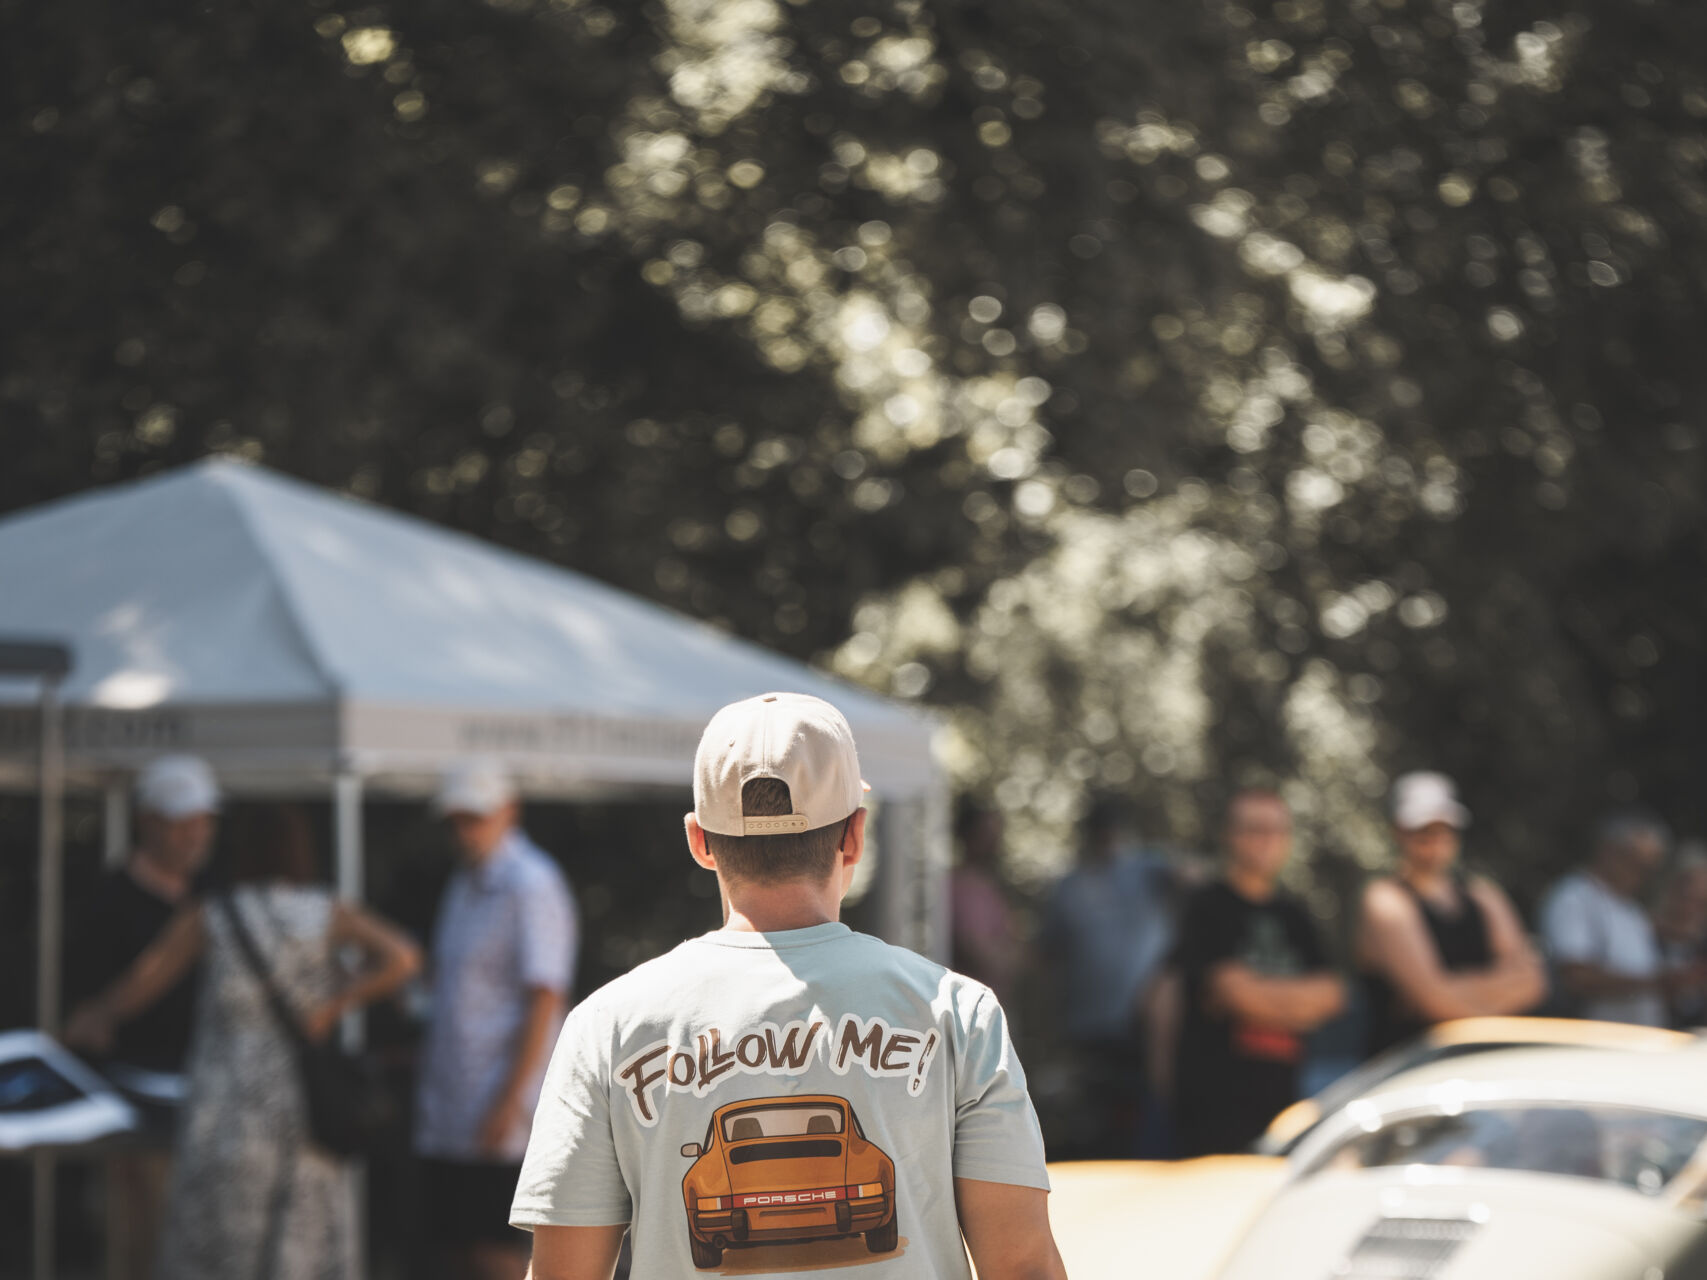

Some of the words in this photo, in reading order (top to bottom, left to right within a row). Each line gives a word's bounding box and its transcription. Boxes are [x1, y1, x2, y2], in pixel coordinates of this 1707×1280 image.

[620, 1021, 823, 1120] FOLLOW
[836, 1019, 937, 1091] ME!
[743, 1190, 837, 1205] PORSCHE
